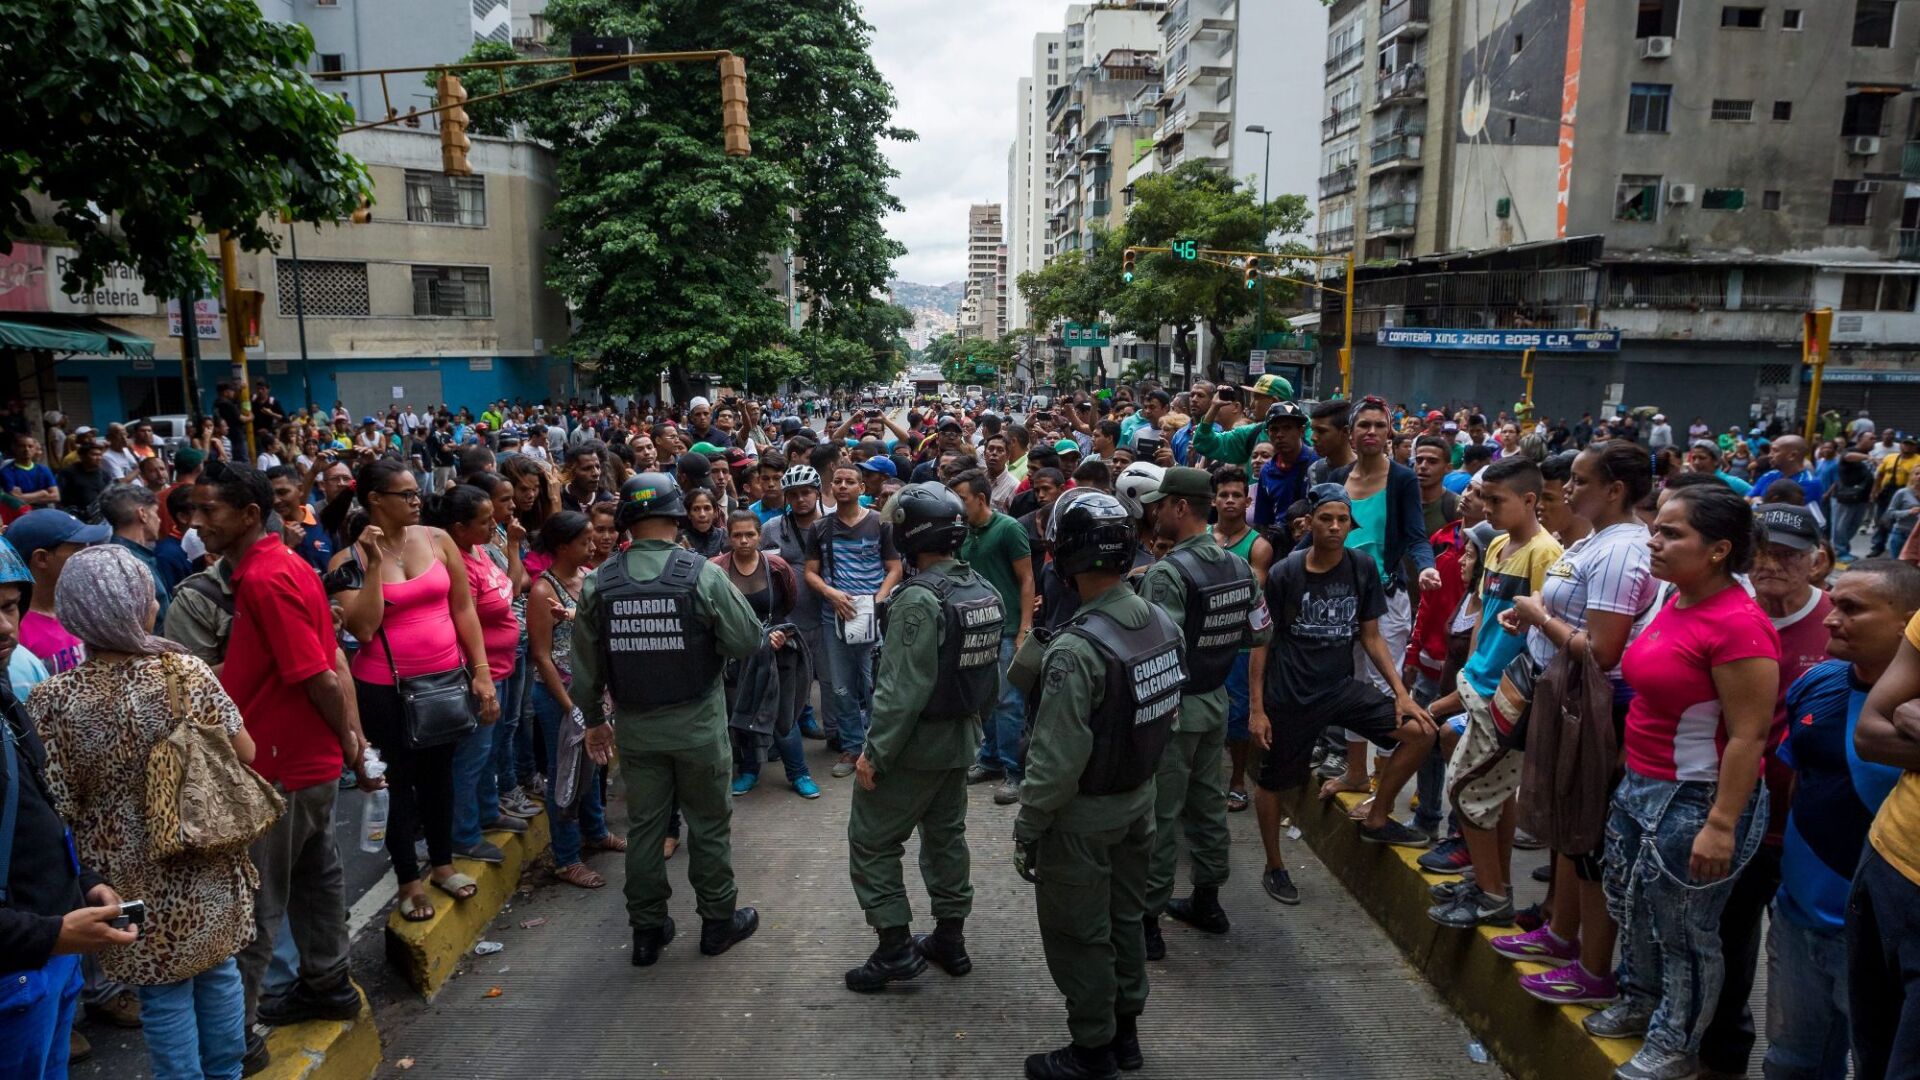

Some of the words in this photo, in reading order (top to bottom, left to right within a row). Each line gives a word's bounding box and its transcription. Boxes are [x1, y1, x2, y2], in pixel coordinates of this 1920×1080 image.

[1174, 241, 1196, 260] 46
[1436, 333, 1458, 344] XING
[1462, 334, 1500, 345] ZHENG
[612, 598, 677, 615] GUARDIA
[1209, 586, 1251, 609] GUARDIA
[610, 618, 683, 633] NACIONAL
[609, 636, 685, 651] BOLIVARIANA
[1133, 648, 1179, 682] GUARDIA
[1135, 665, 1187, 701] NACIONAL
